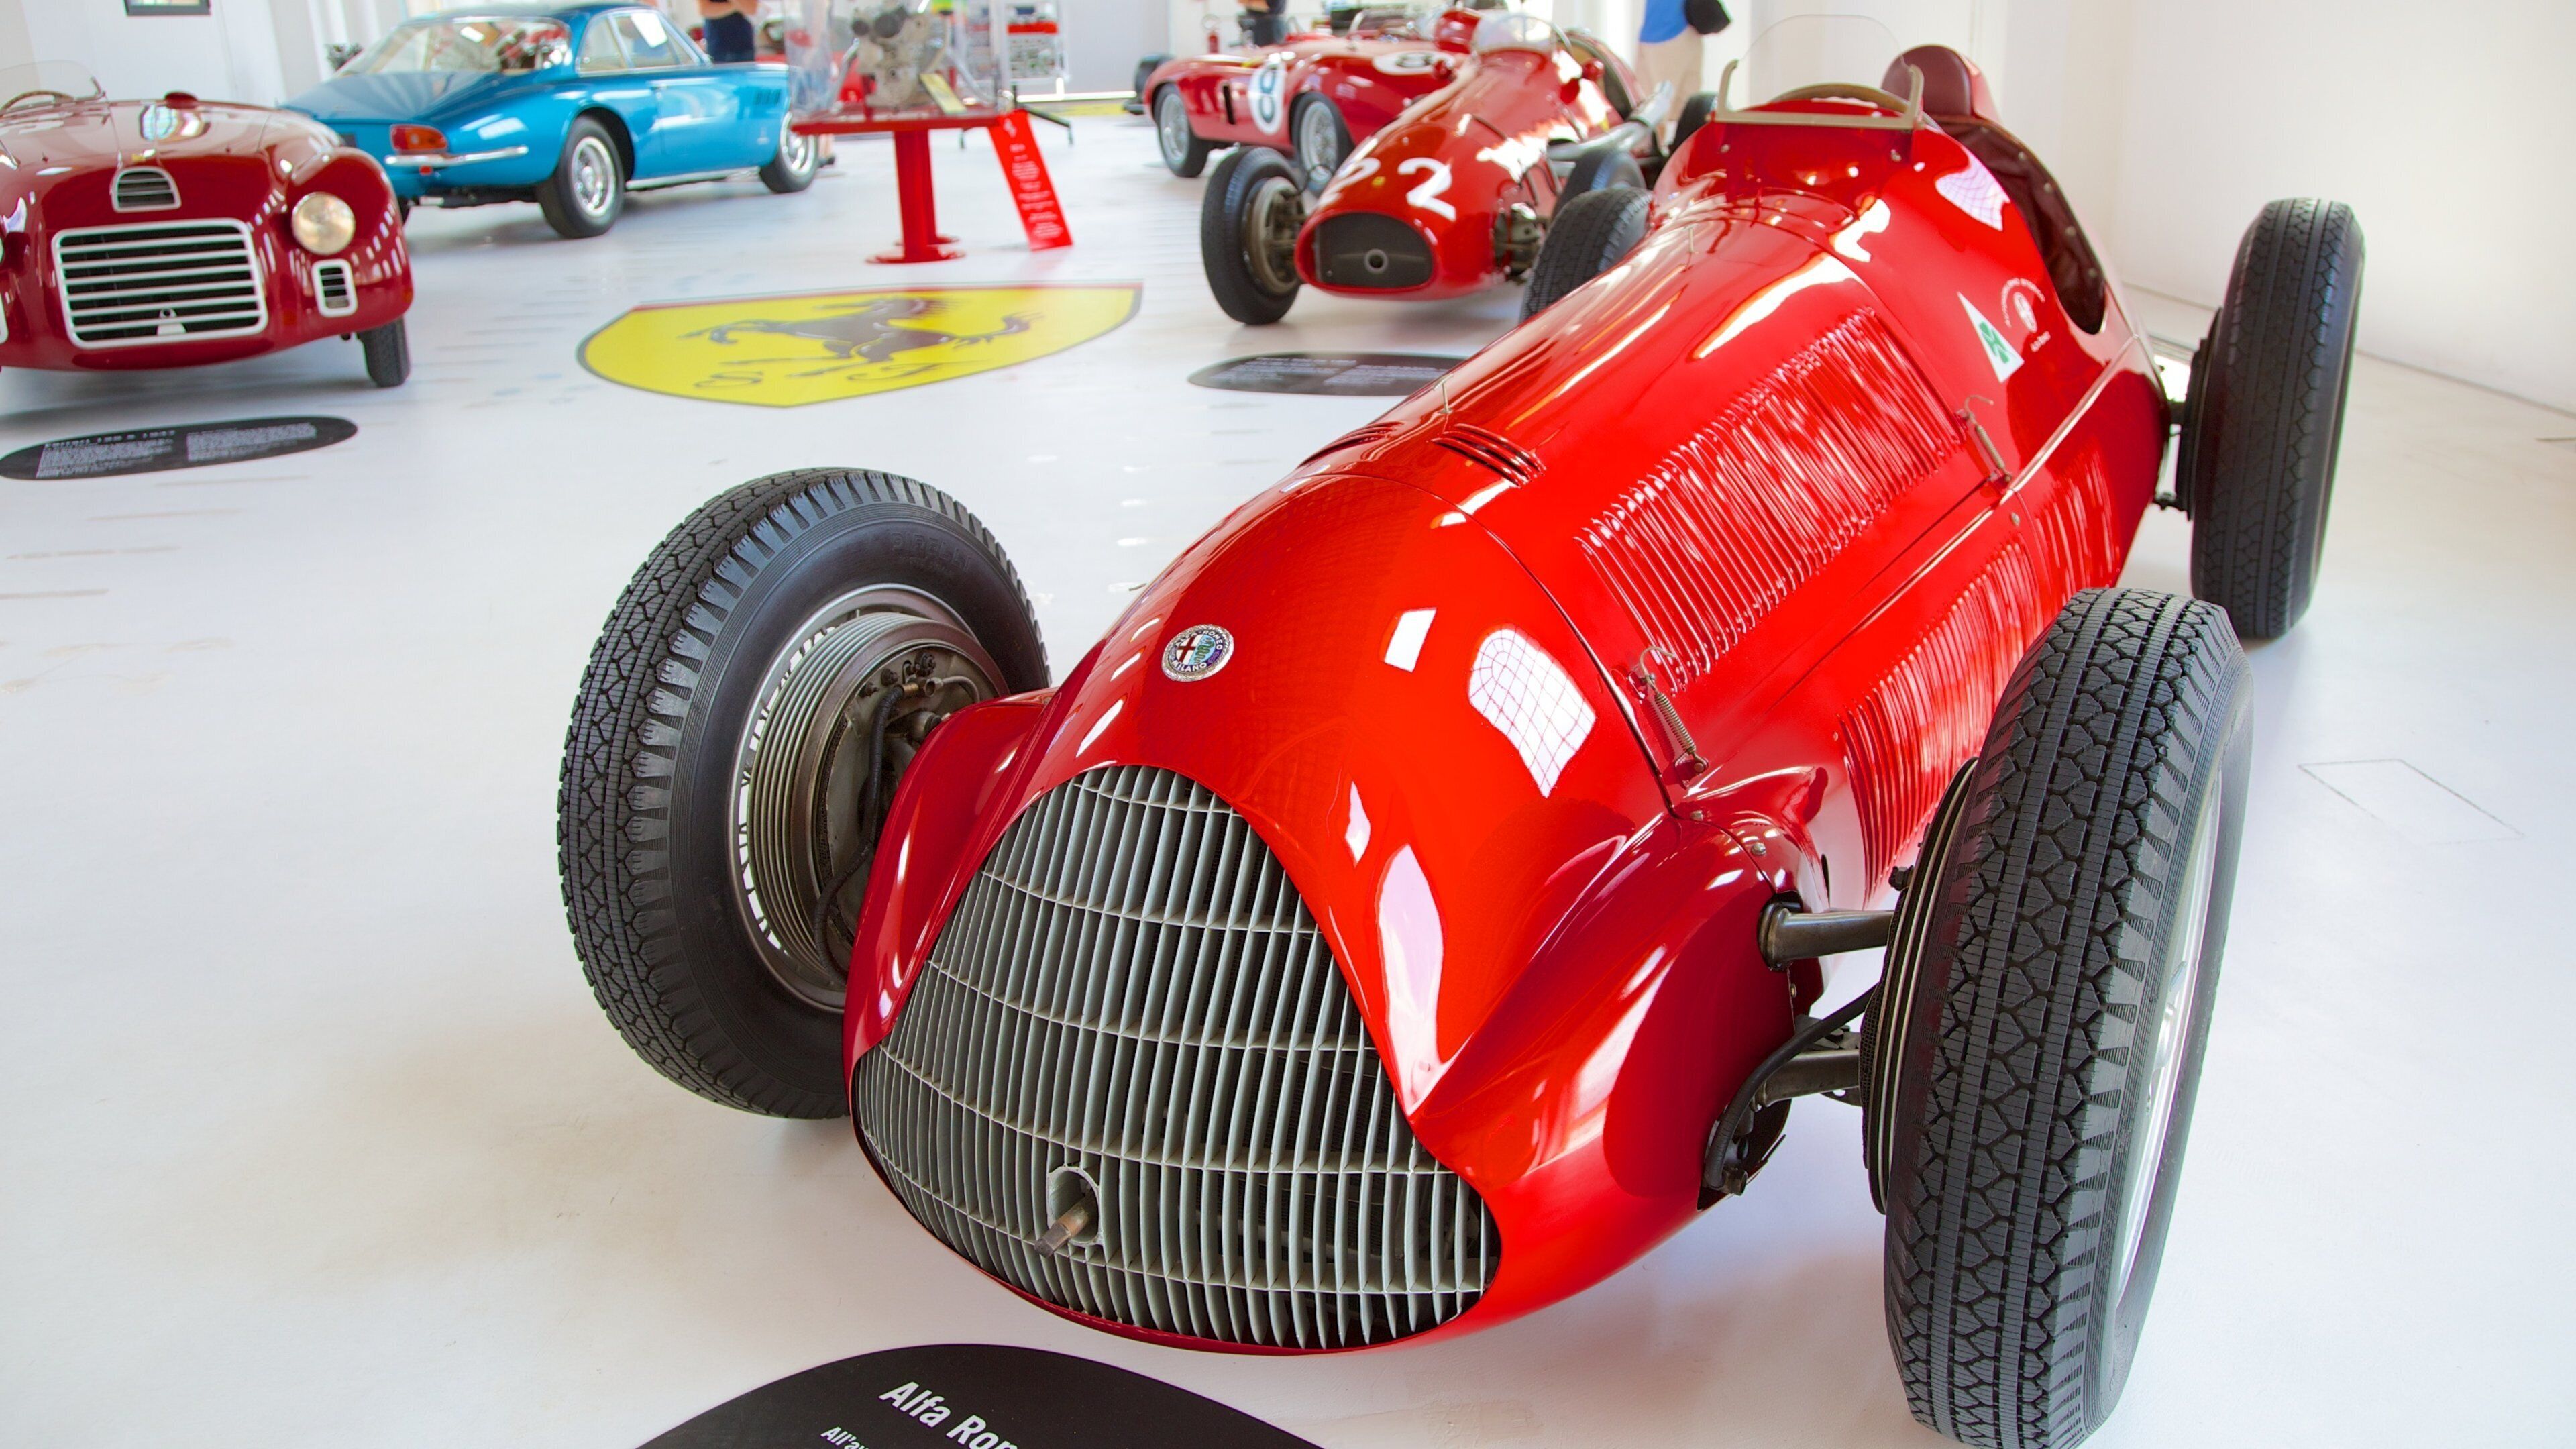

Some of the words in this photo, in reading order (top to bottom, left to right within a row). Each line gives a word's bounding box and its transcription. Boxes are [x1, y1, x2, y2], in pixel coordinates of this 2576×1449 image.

[1259, 65, 1275, 123] 8
[1203, 630, 1223, 650] ROMEO
[1172, 661, 1207, 672] MILANO
[878, 1381, 951, 1428] Alfa
[946, 1415, 1017, 1449] Ro
[820, 1426, 869, 1449] All'a
